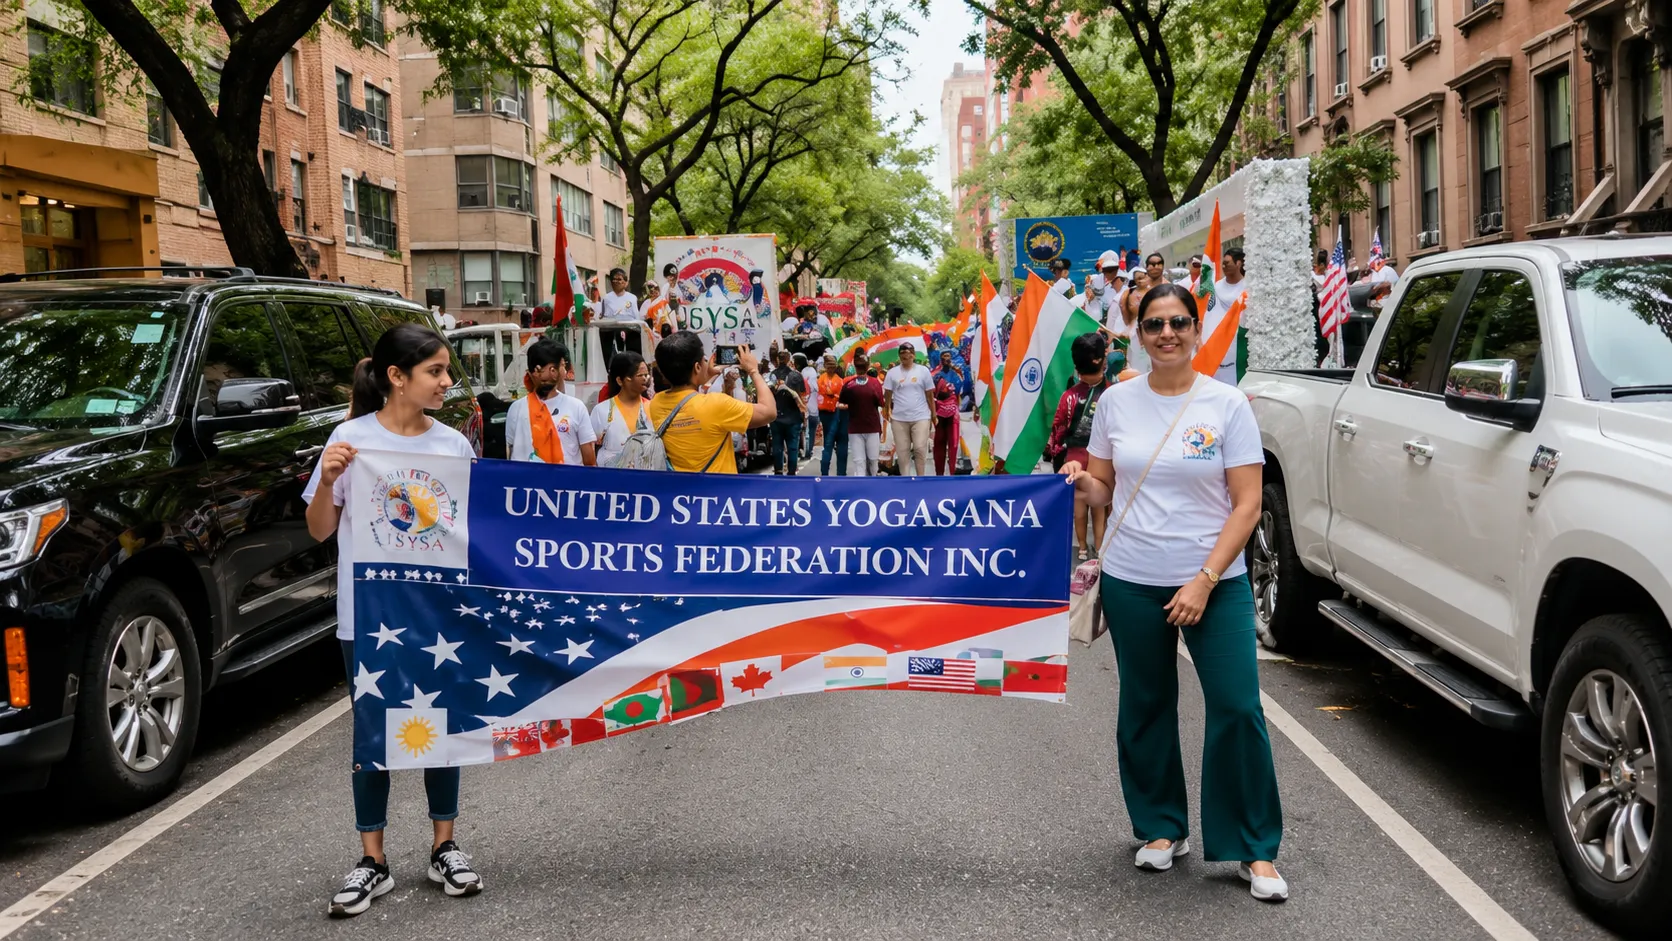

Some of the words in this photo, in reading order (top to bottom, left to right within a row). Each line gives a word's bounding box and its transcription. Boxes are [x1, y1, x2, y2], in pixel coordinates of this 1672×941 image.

[503, 487, 661, 524] UNITED
[671, 495, 811, 526] STATES
[821, 498, 1043, 529] YOGASANA
[514, 537, 663, 574] SPORTS
[673, 545, 934, 577] FEDERATION
[943, 547, 1026, 579] INC.
